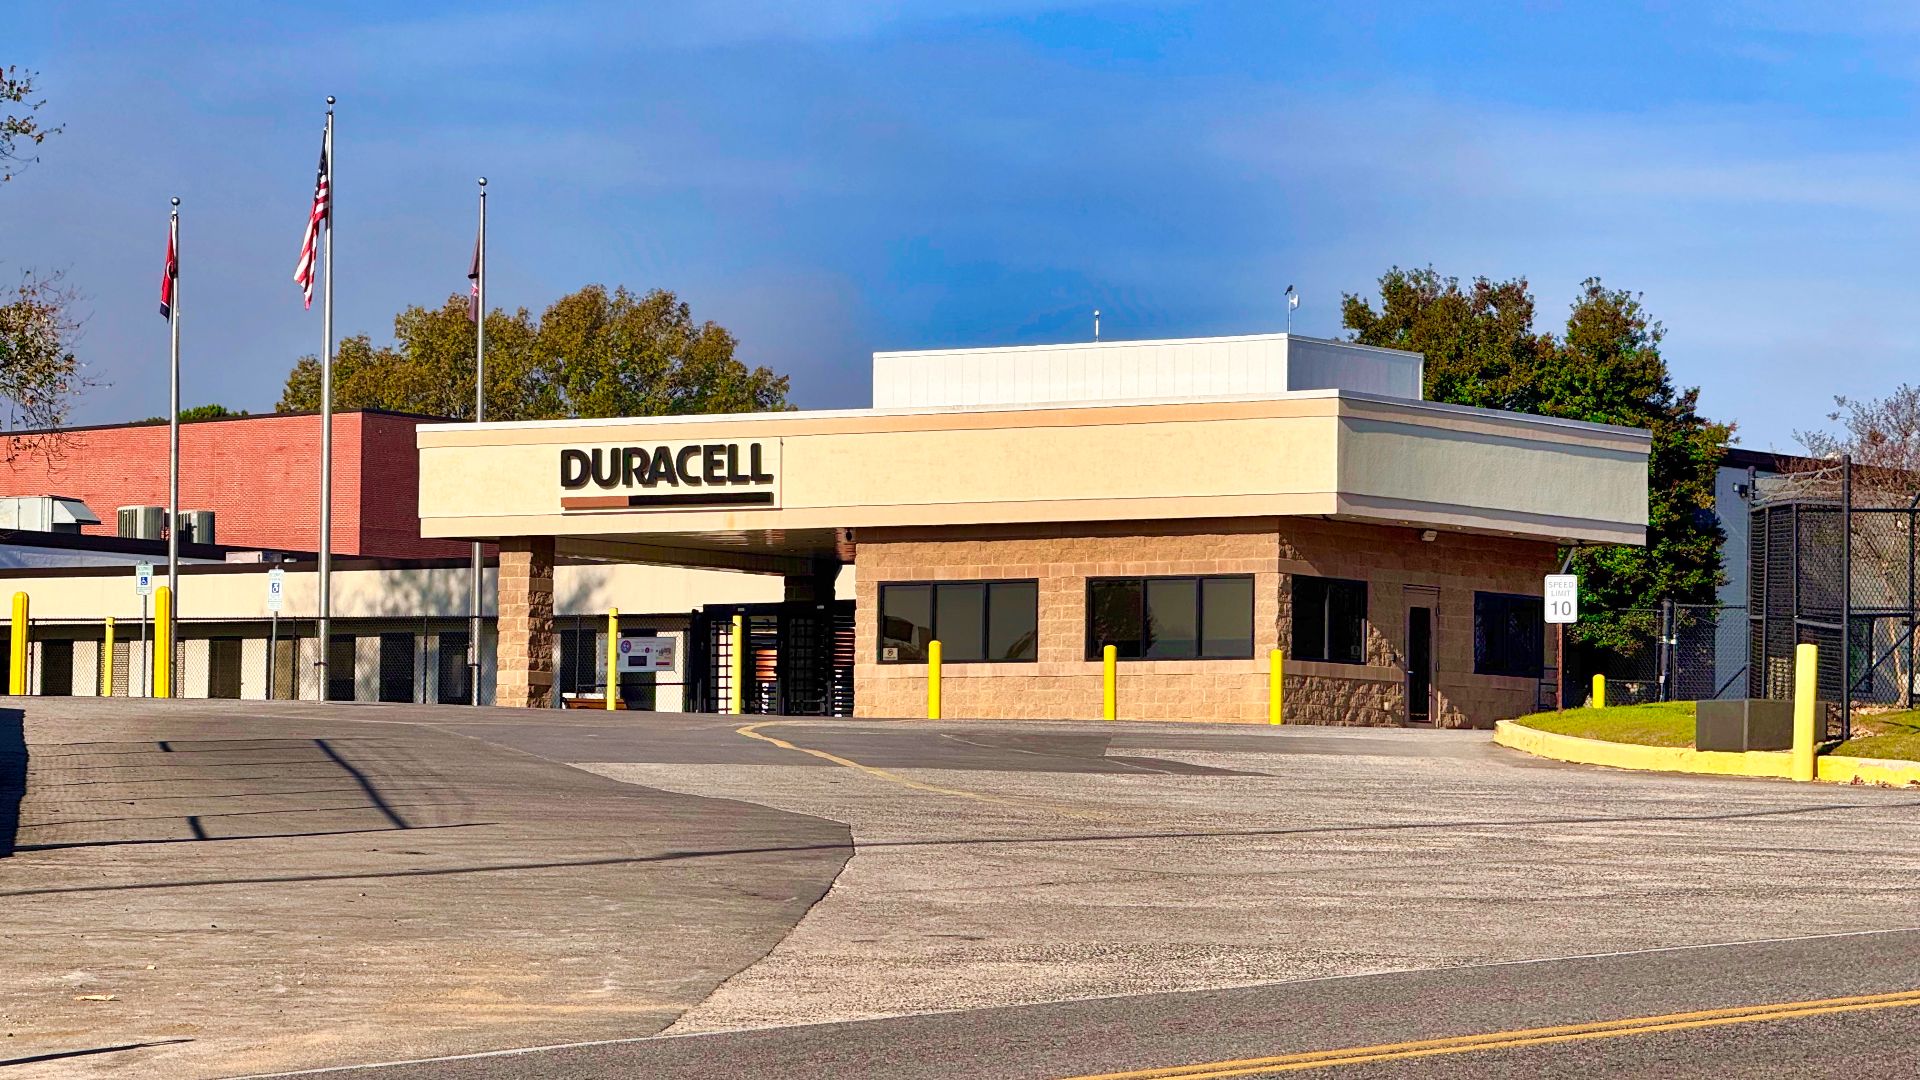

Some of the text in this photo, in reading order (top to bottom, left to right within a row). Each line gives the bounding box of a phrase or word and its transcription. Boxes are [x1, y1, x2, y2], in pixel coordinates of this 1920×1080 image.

[561, 443, 774, 489] DURACELL
[1548, 581, 1574, 589] SPEED
[1550, 600, 1572, 616] 10
